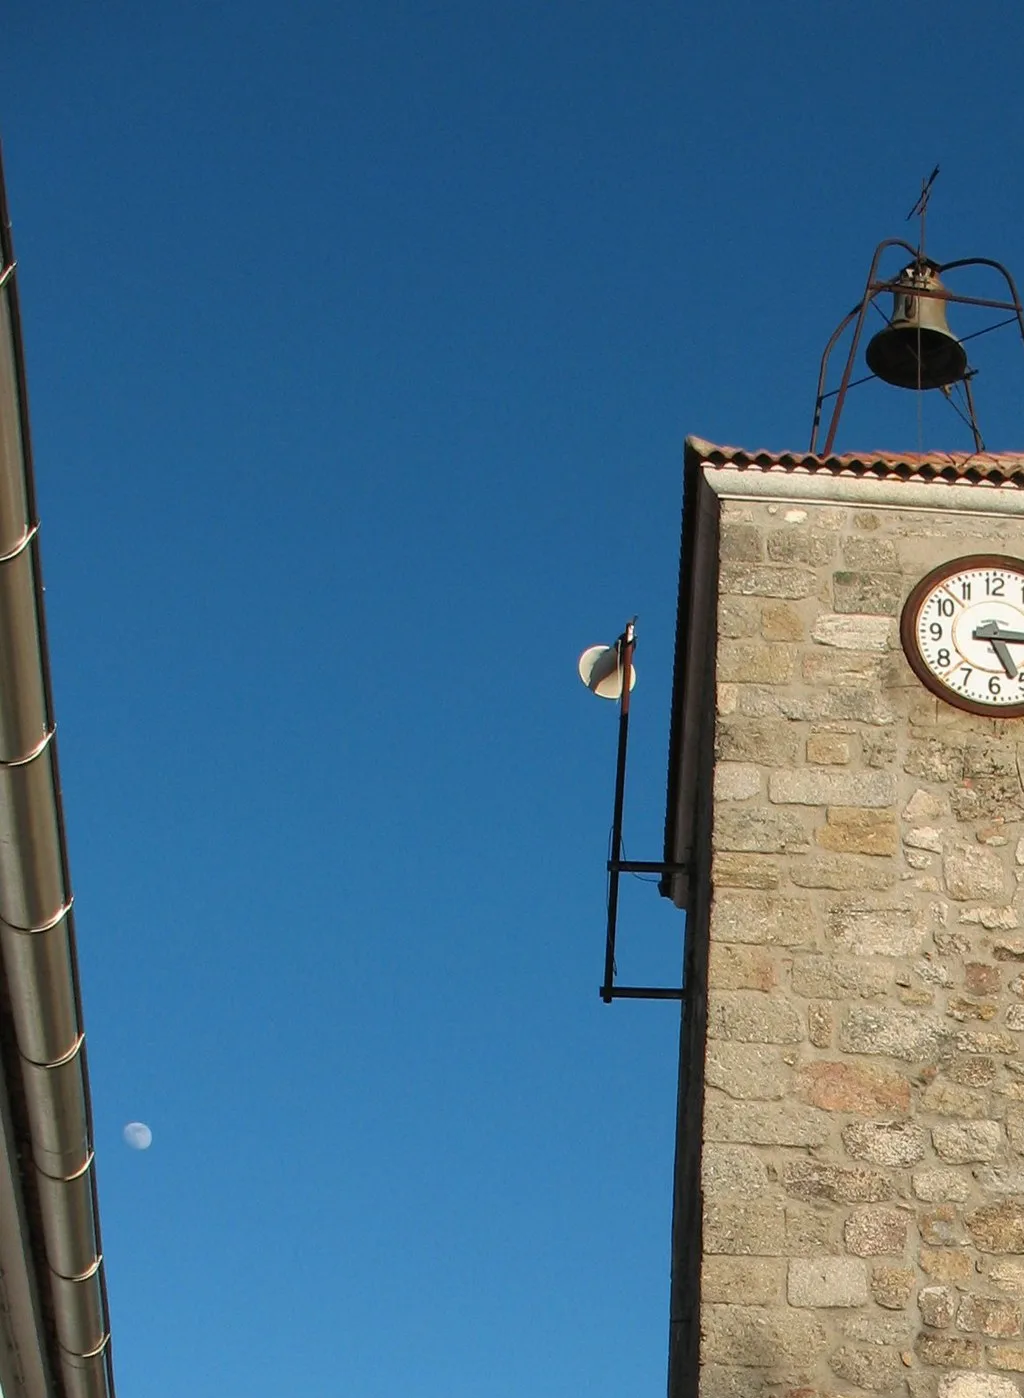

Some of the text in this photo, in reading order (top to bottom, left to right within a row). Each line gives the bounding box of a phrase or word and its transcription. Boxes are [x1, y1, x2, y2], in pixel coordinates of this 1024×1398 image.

[961, 582, 971, 601] 11
[985, 577, 1005, 597] 12
[937, 598, 955, 617] 10
[929, 622, 943, 641] 9
[937, 648, 951, 668] 8
[960, 667, 972, 687] 7
[988, 676, 1001, 695] 6
